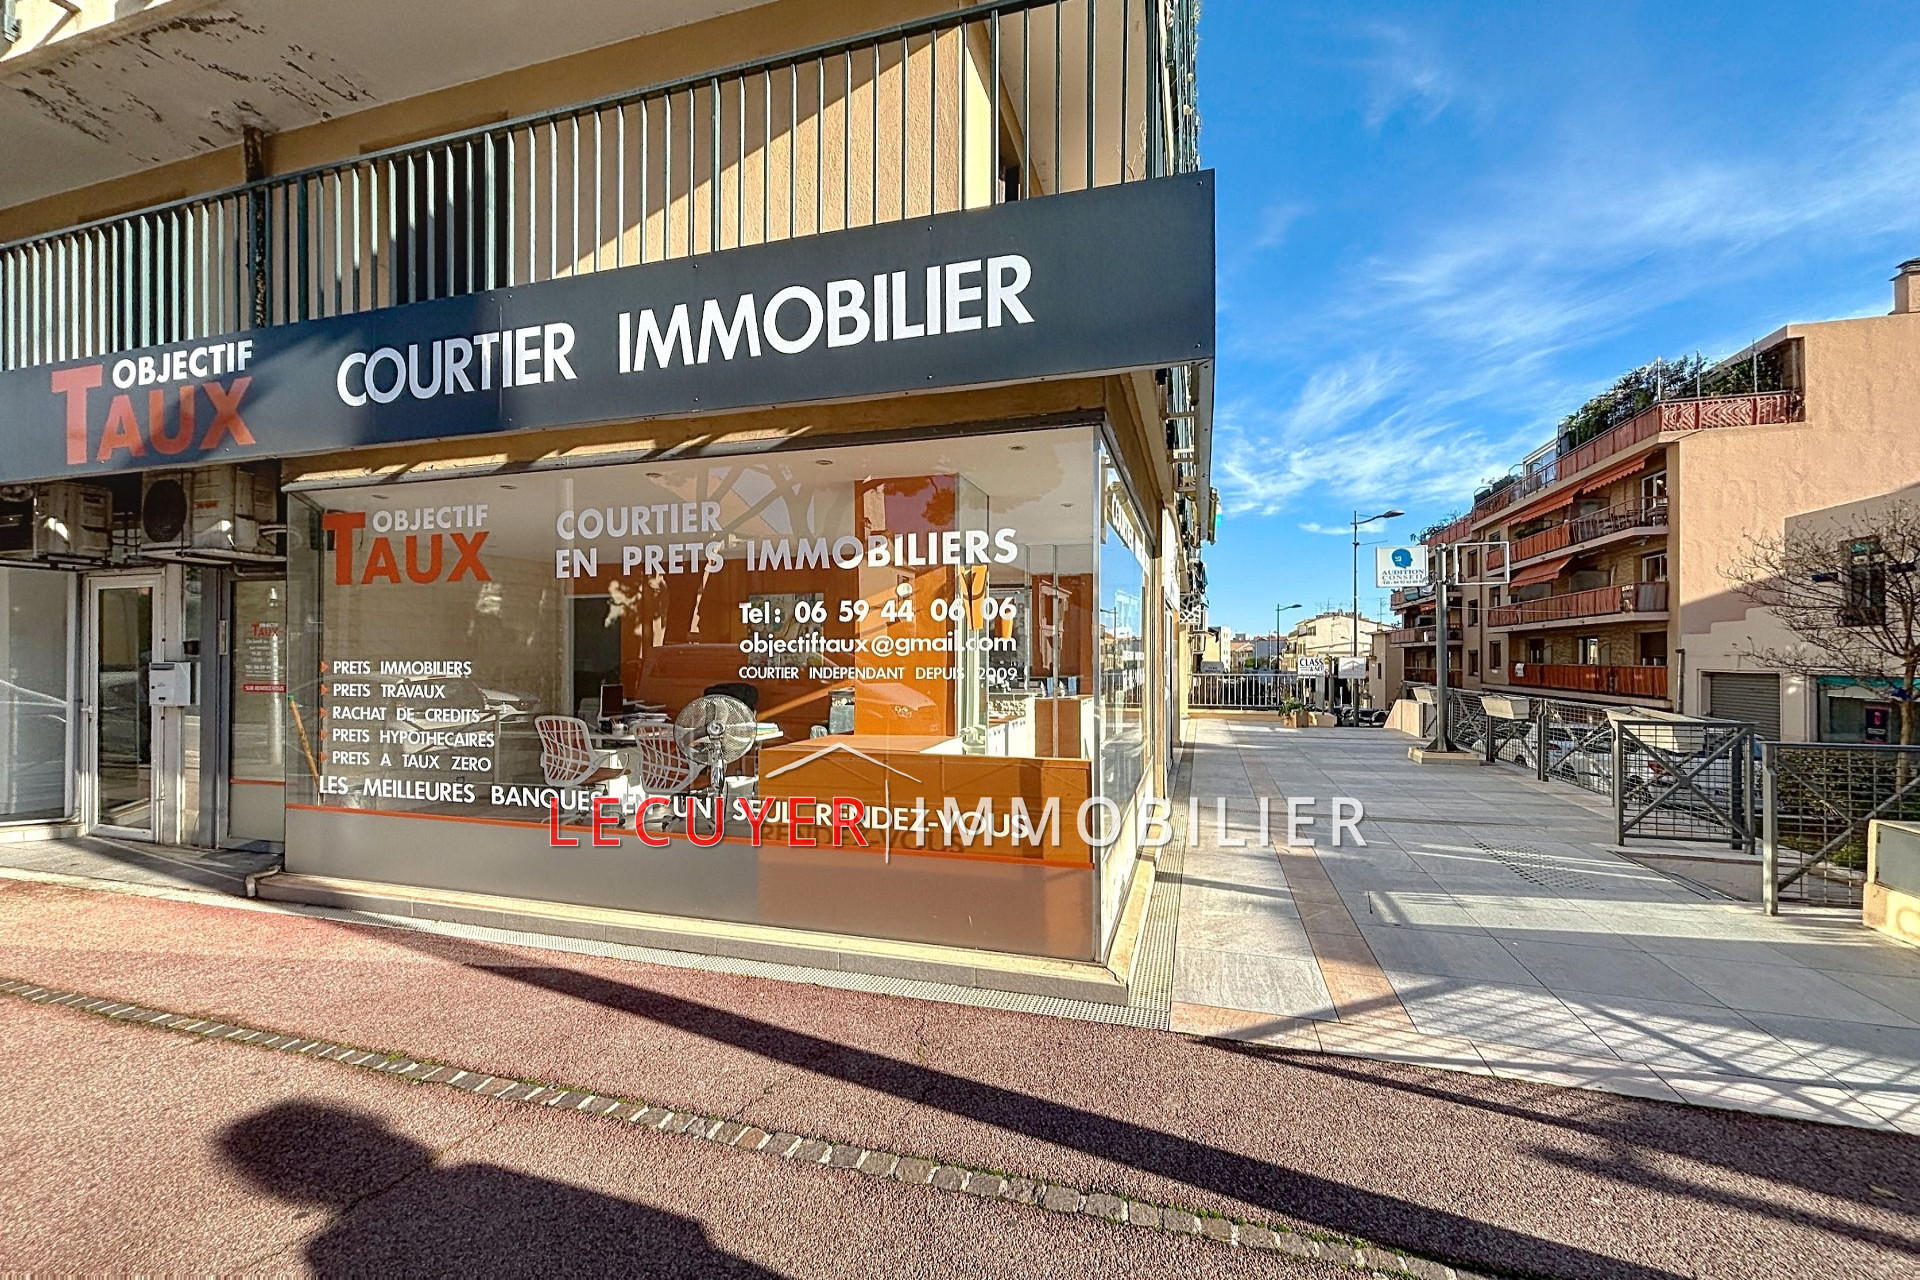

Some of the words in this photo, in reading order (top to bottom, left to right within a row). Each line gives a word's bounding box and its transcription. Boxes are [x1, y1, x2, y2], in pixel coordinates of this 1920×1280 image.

[337, 322, 578, 407] COURTIER
[618, 254, 1035, 373] IMMOBILIER
[112, 339, 253, 389] OBJECTIF
[51, 363, 257, 465] TAUX
[372, 504, 488, 533] OBJECTIF
[556, 501, 722, 540] COURTIER
[323, 512, 492, 585] TAUX
[556, 547, 598, 578] EN
[623, 541, 724, 577] PRETS
[746, 528, 1018, 571] IMMOBILIERS
[794, 600, 828, 624] 06
[839, 599, 870, 623] 59
[880, 599, 914, 622] 44
[930, 598, 966, 622] 06
[980, 597, 1017, 621] 06
[739, 630, 1017, 657] objectiftaux@gmail.com
[333, 660, 371, 675] PRETS
[380, 661, 472, 676] IMMOBILIERS
[739, 667, 799, 680] COURTIER
[809, 666, 905, 680] INDEPENDANT
[915, 667, 965, 680] DEPUIS
[978, 667, 1018, 681] 2009
[1300, 658, 1324, 666] CLASS
[333, 684, 370, 698] PRETS
[381, 684, 446, 699] TRAVAUX
[332, 706, 387, 720] RACHAT
[396, 707, 415, 721] DE
[424, 709, 481, 723] CREDITS
[332, 729, 370, 743] PRETS
[379, 730, 495, 748] HYPOTHECAIRES
[332, 751, 370, 765] PRETS
[380, 753, 392, 767] A
[402, 754, 440, 769] TAUX
[451, 756, 492, 772] ZERO
[319, 776, 349, 795] LES
[363, 778, 476, 804] MEILLEURES
[491, 786, 604, 811] BANQUES
[815, 803, 1030, 839] RENDEZ-VOUS
